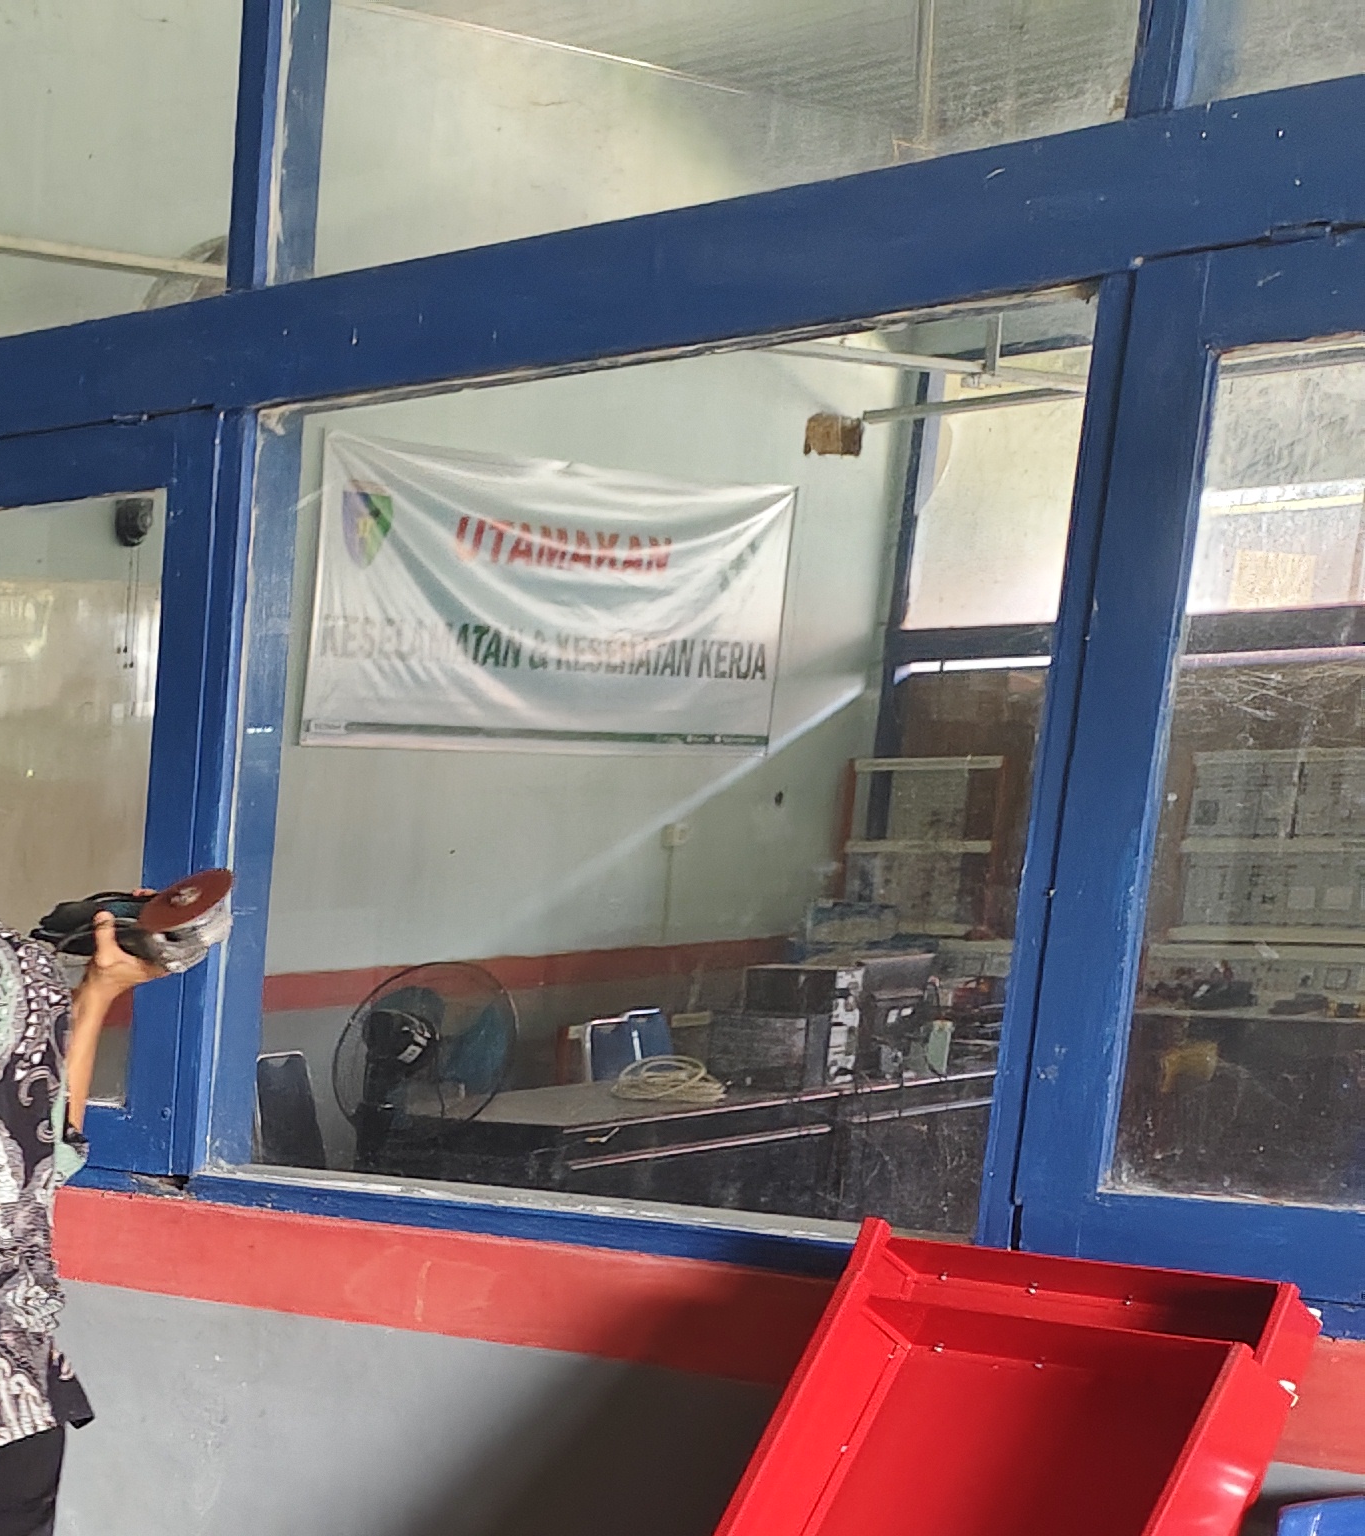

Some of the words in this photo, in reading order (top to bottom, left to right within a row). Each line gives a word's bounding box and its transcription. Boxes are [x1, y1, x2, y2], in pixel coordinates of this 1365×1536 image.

[454, 514, 672, 575] UTAMAKAN
[318, 613, 521, 669] KESELAATAN
[697, 639, 767, 682] KERJA
